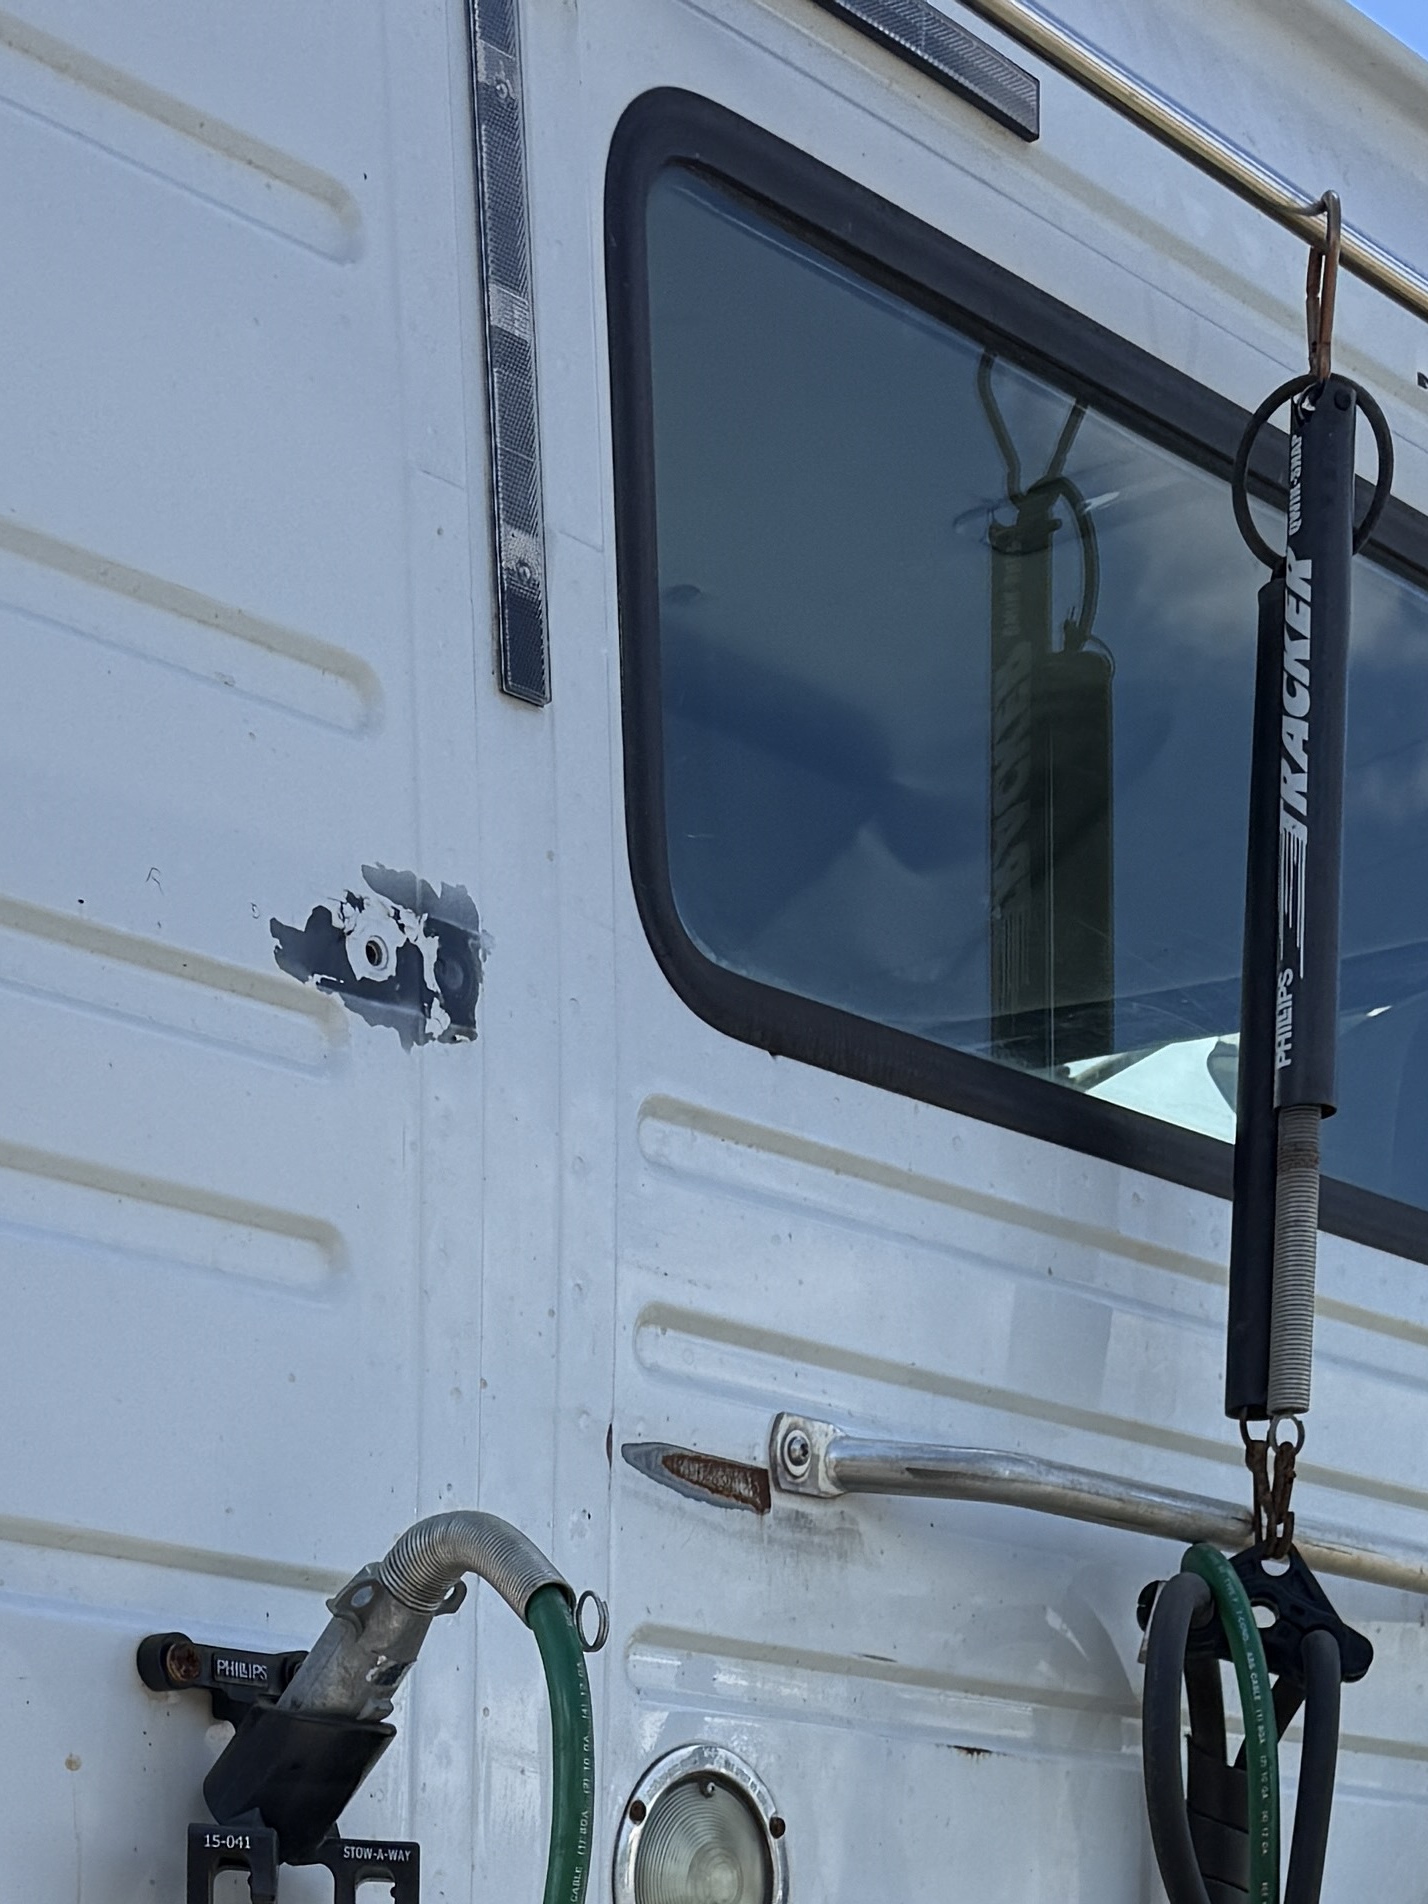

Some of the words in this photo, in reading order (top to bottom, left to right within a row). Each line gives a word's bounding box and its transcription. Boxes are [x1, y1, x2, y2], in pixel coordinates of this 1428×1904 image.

[1280, 546, 1312, 846] TRACKER
[1276, 968, 1293, 1069] PHILLIPS
[216, 1659, 268, 1681] PHILLIPS
[204, 1834, 251, 1849] 15-041
[343, 1846, 412, 1862] STOW-A-WAY
[570, 1866, 582, 1903] CABLE
